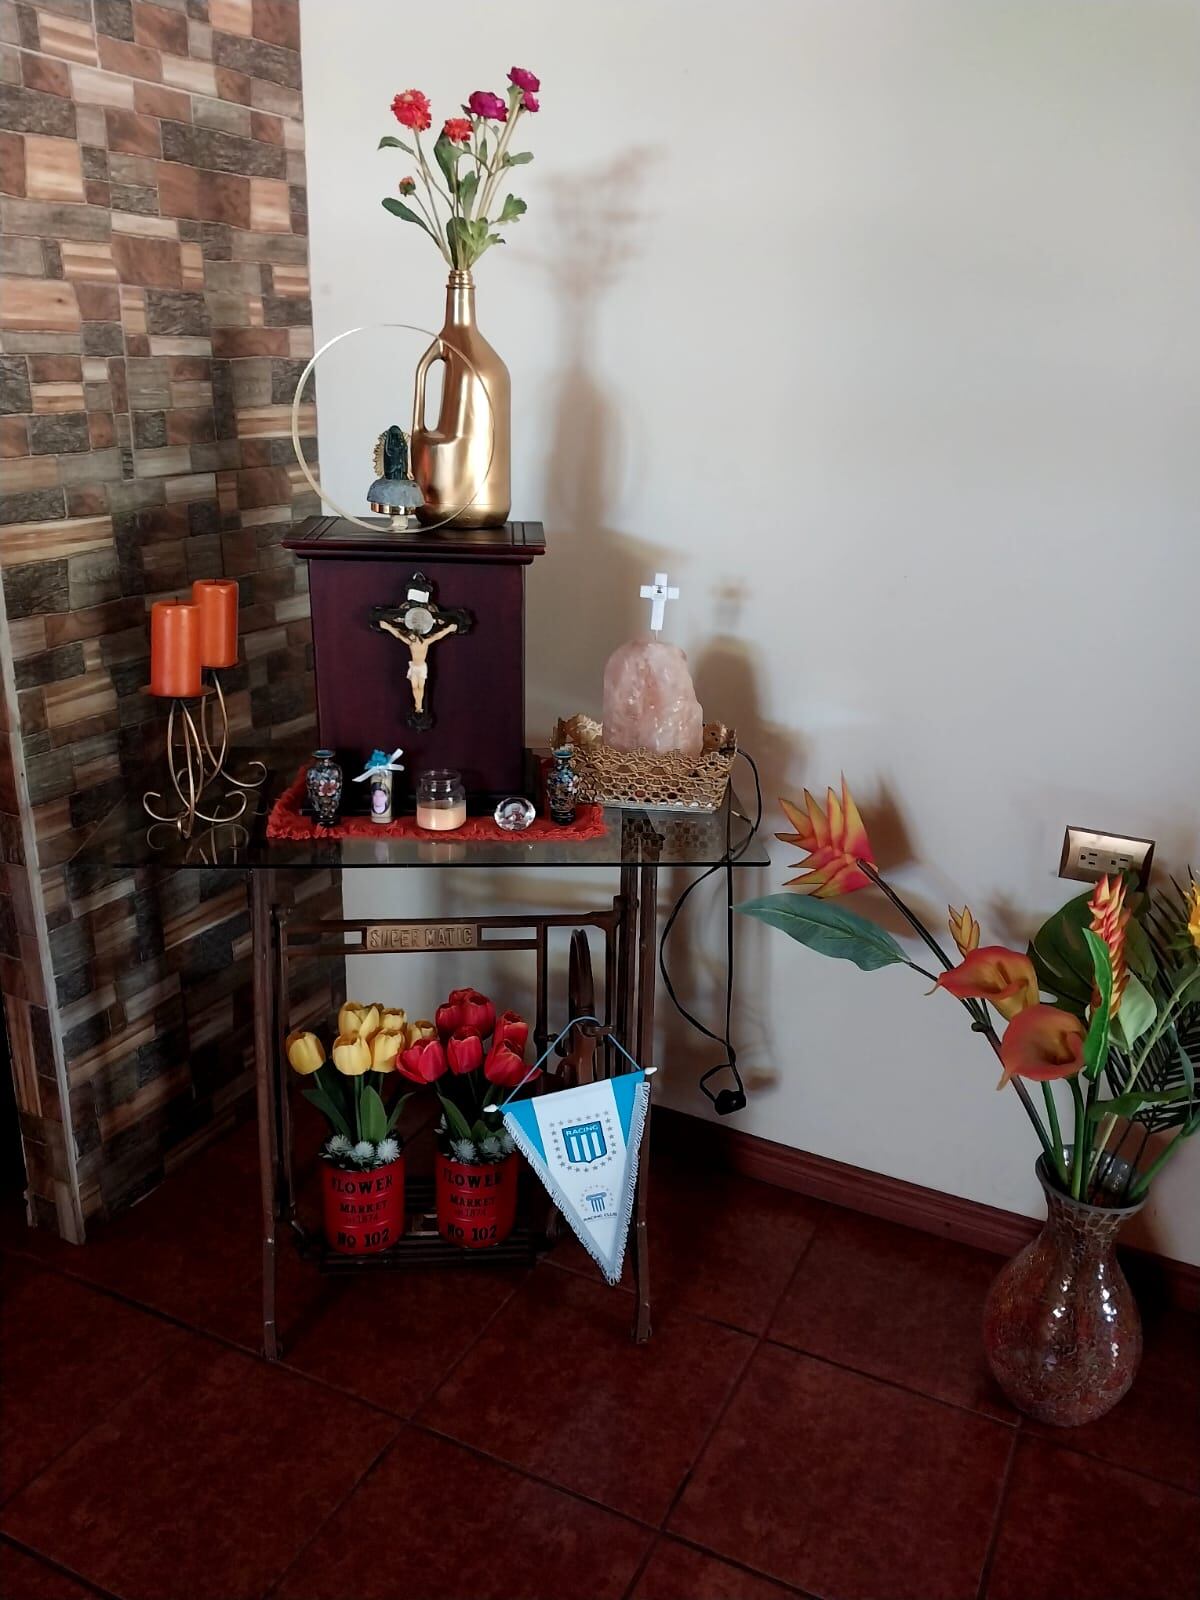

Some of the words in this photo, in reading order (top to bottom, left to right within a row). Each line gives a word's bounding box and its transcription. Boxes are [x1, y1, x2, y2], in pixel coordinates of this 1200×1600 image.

[370, 929, 420, 948] SUPER
[425, 927, 472, 946] MATIC
[566, 1124, 599, 1137] RACING
[331, 1174, 393, 1194] FLOWER
[340, 1200, 389, 1214] MARKET
[450, 1193, 497, 1208] MARKET
[364, 1227, 390, 1248] 102
[471, 1224, 497, 1241] 102
